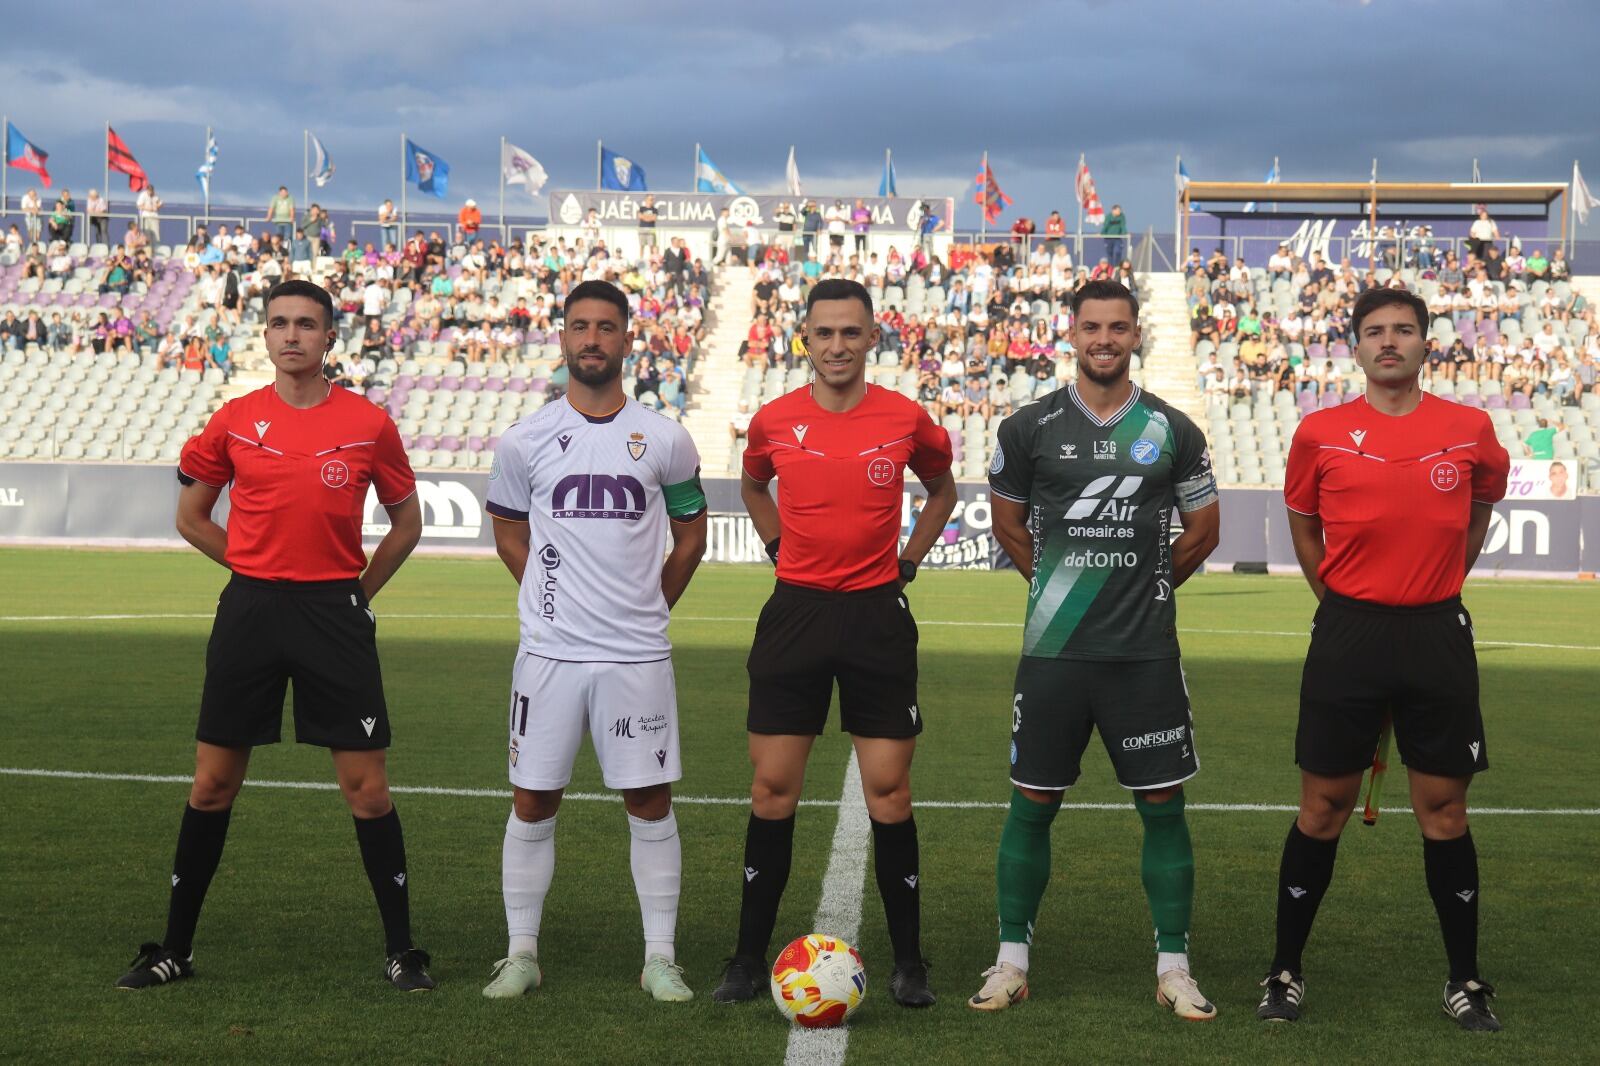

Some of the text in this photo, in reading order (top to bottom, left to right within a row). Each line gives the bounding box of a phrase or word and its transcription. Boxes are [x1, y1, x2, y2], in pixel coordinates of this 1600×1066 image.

[1093, 441, 1117, 454] L3G
[1097, 499, 1139, 521] Air
[1068, 525, 1135, 538] oneair.es
[1064, 549, 1138, 568] datono
[512, 690, 530, 736] 11
[1122, 730, 1177, 750] CONFISUR
